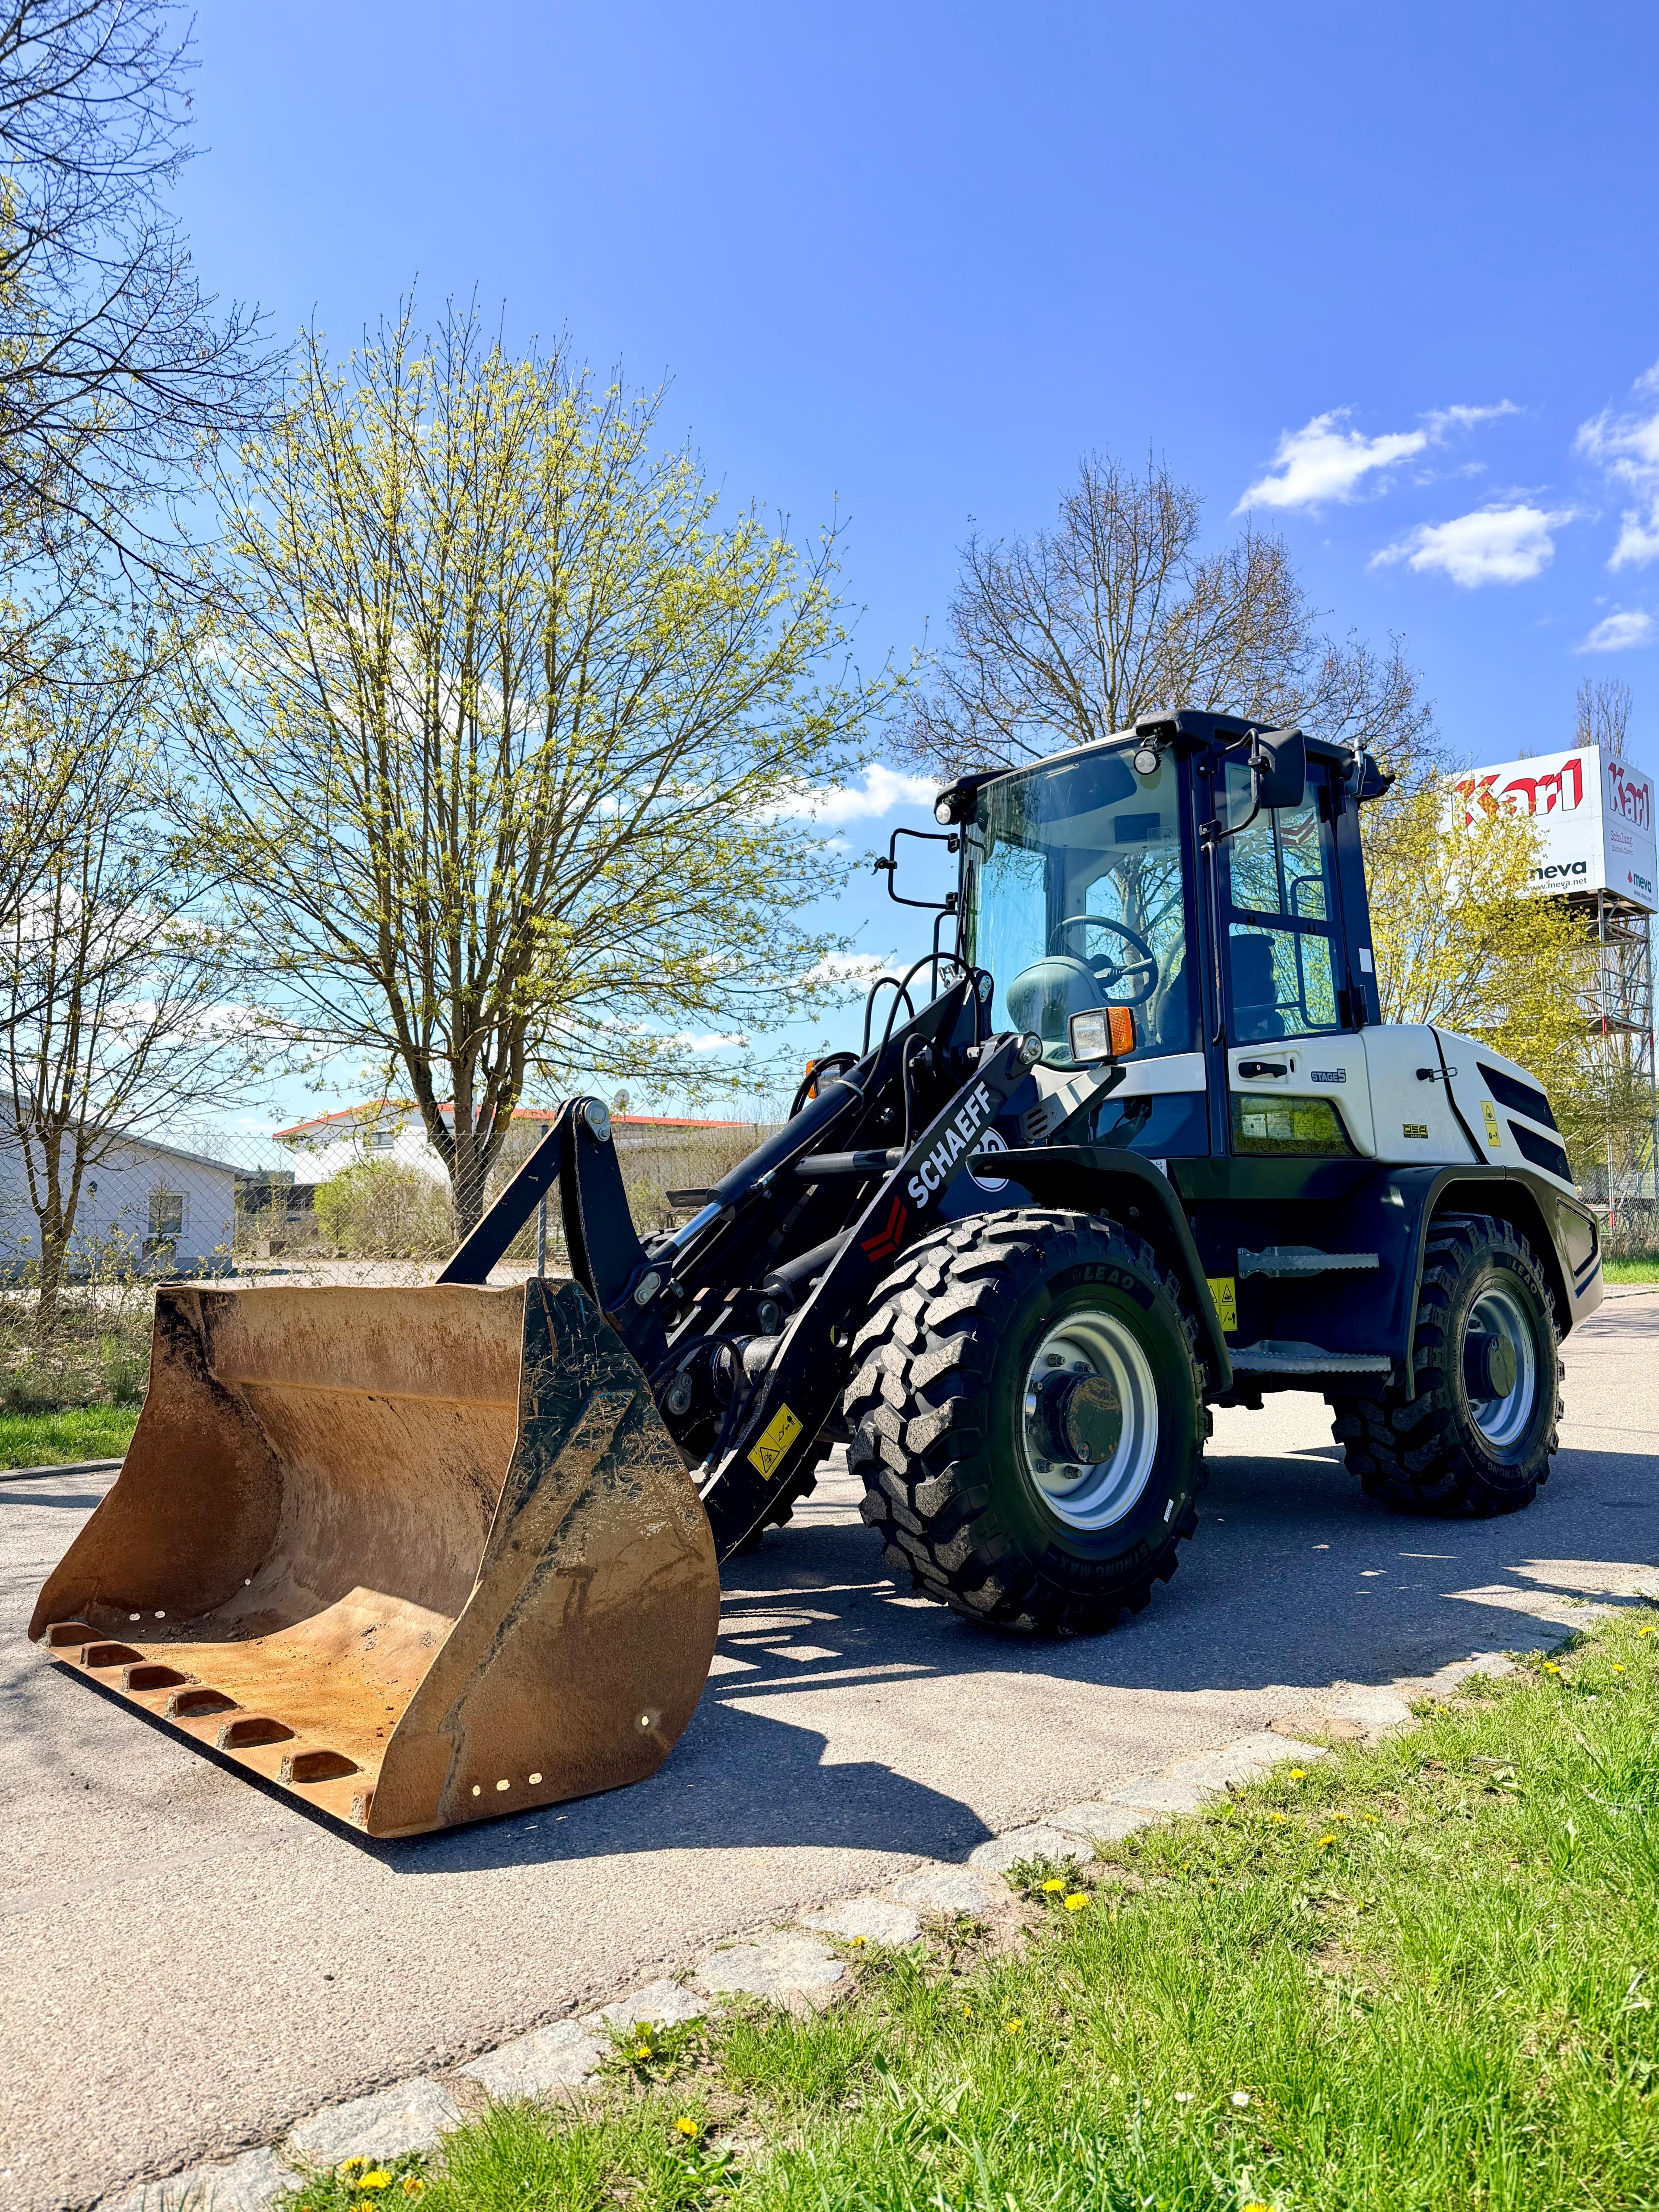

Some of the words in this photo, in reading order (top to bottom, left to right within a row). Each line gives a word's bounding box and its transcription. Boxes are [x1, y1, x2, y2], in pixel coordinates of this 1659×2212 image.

[1451, 758, 1583, 835] Karl
[1608, 762, 1649, 831] Karl
[1634, 873, 1652, 894] meva
[908, 1081, 991, 1208] SCHAEFF
